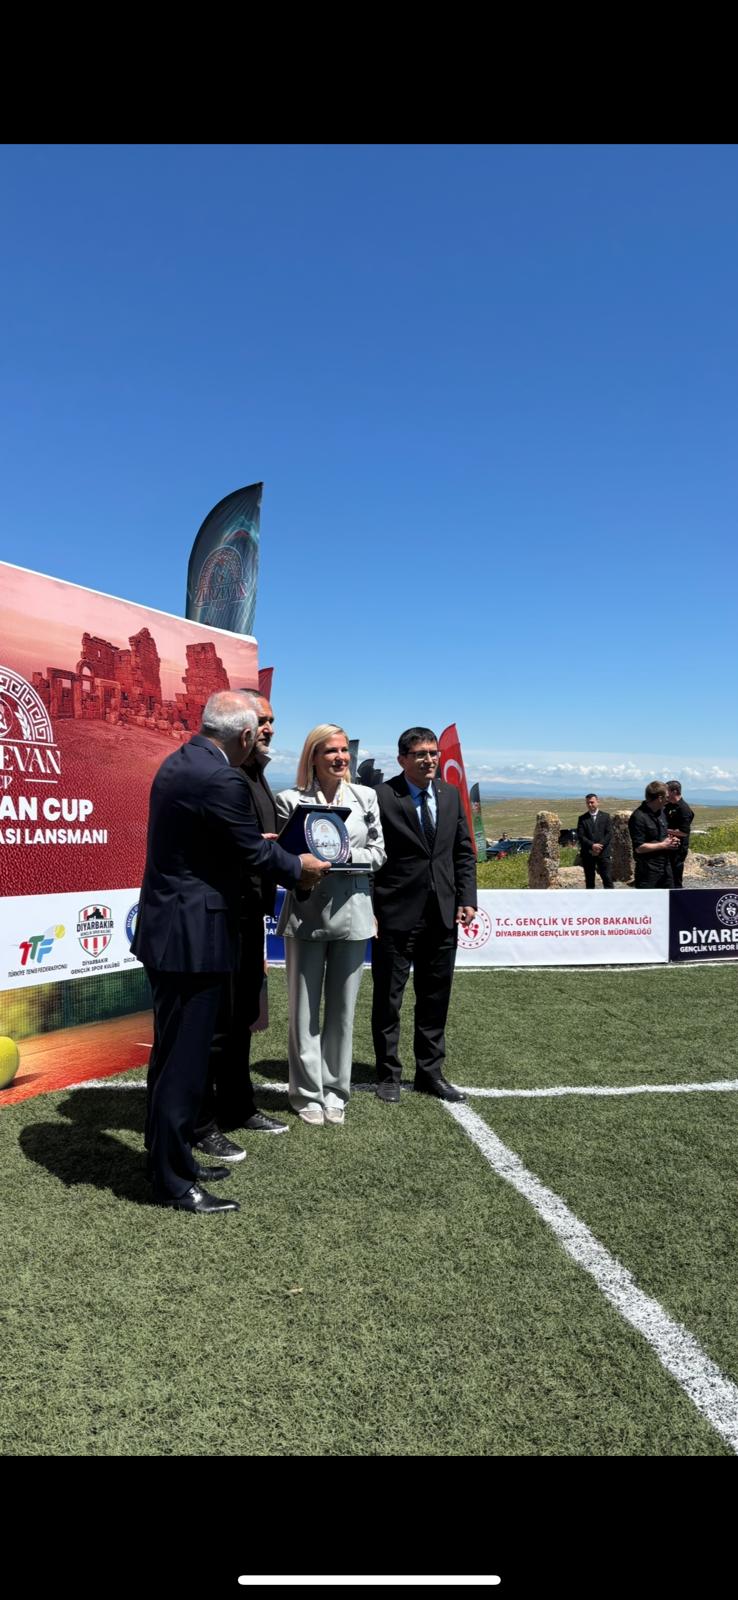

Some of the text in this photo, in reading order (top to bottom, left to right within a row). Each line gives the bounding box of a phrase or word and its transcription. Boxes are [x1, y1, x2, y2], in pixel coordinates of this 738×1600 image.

[0, 796, 93, 821] AN CUP
[25, 829, 107, 844] LANSMANI
[495, 915, 652, 928] T.C. GENÇLİK VE SPOR BAKANLIĞI
[495, 929, 538, 938] DİYARBAKIR
[539, 929, 569, 938] GENÇLİK
[600, 928, 606, 936] İL
[608, 928, 652, 936] MÜDÜRLÜĞÜ
[19, 935, 54, 966] TTF
[680, 945, 708, 954] GENÇLİK
